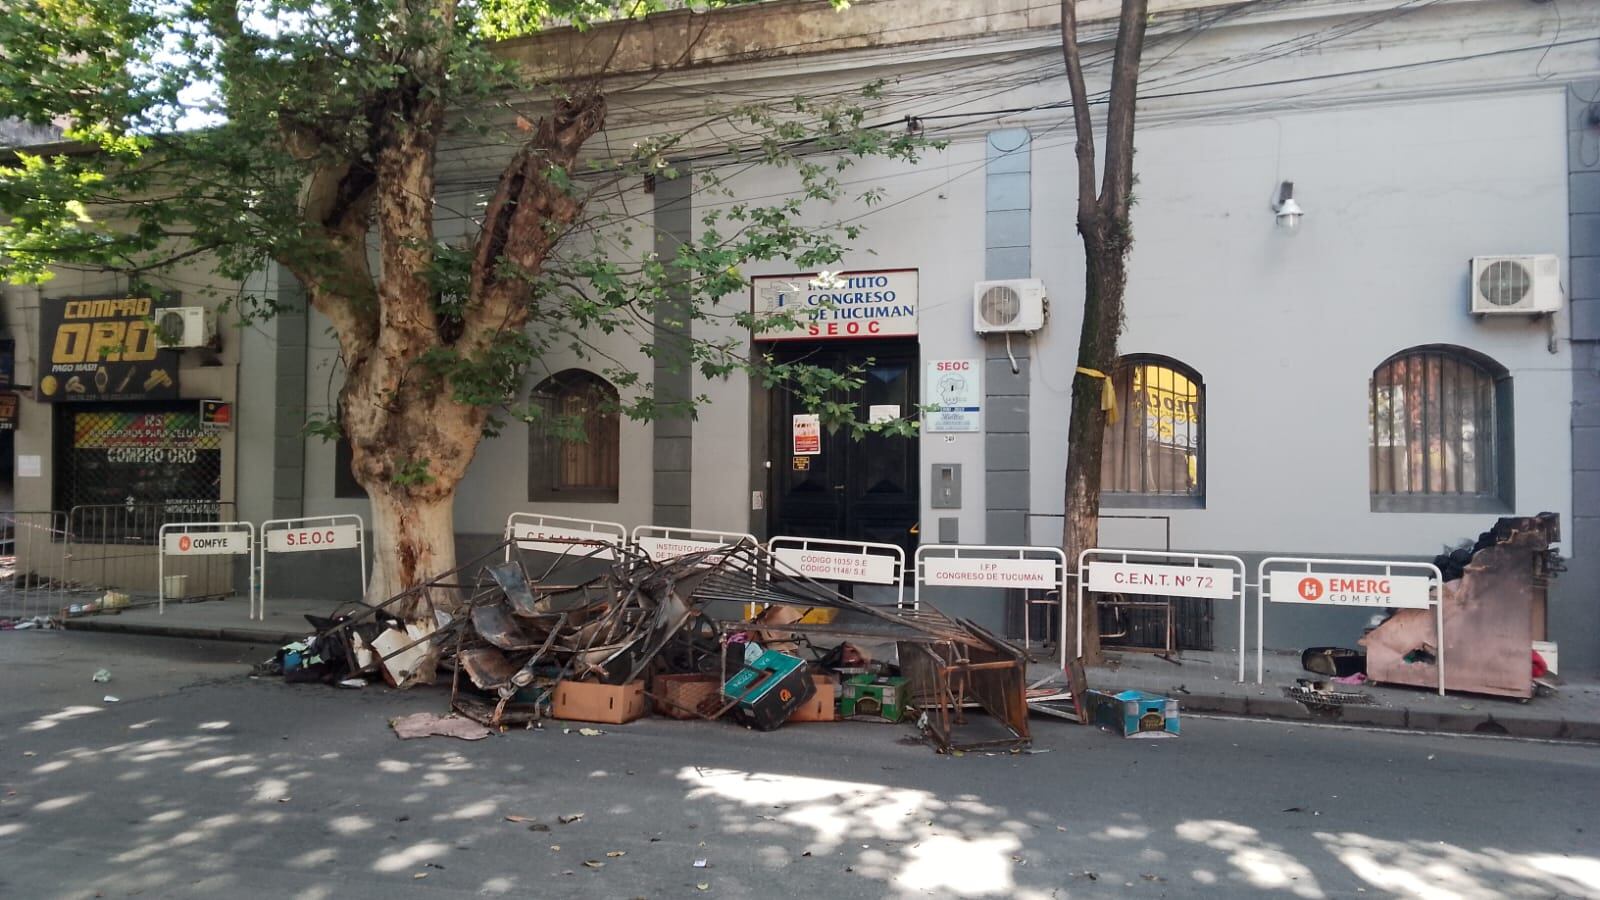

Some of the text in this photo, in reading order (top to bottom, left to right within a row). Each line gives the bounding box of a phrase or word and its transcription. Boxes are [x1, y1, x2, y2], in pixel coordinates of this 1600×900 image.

[808, 291, 896, 306] CONGRESO
[64, 298, 152, 319] COMPRO
[834, 305, 914, 320] TUCUMAN
[52, 320, 158, 364] ORO
[937, 361, 970, 371] SEOC
[107, 447, 197, 463] COMPRO ORO
[193, 538, 228, 548] COMFYE
[287, 531, 335, 546] S.E.O.C
[656, 543, 692, 552] INSTITUTO
[800, 555, 831, 564] CODIGO
[800, 563, 830, 573] CODIGO
[936, 572, 984, 580] CONGRESO
[1001, 573, 1044, 581] TUCUMAN
[1196, 576, 1214, 589] 72
[1329, 578, 1392, 594] EMERG
[1329, 594, 1392, 604] COMFYE
